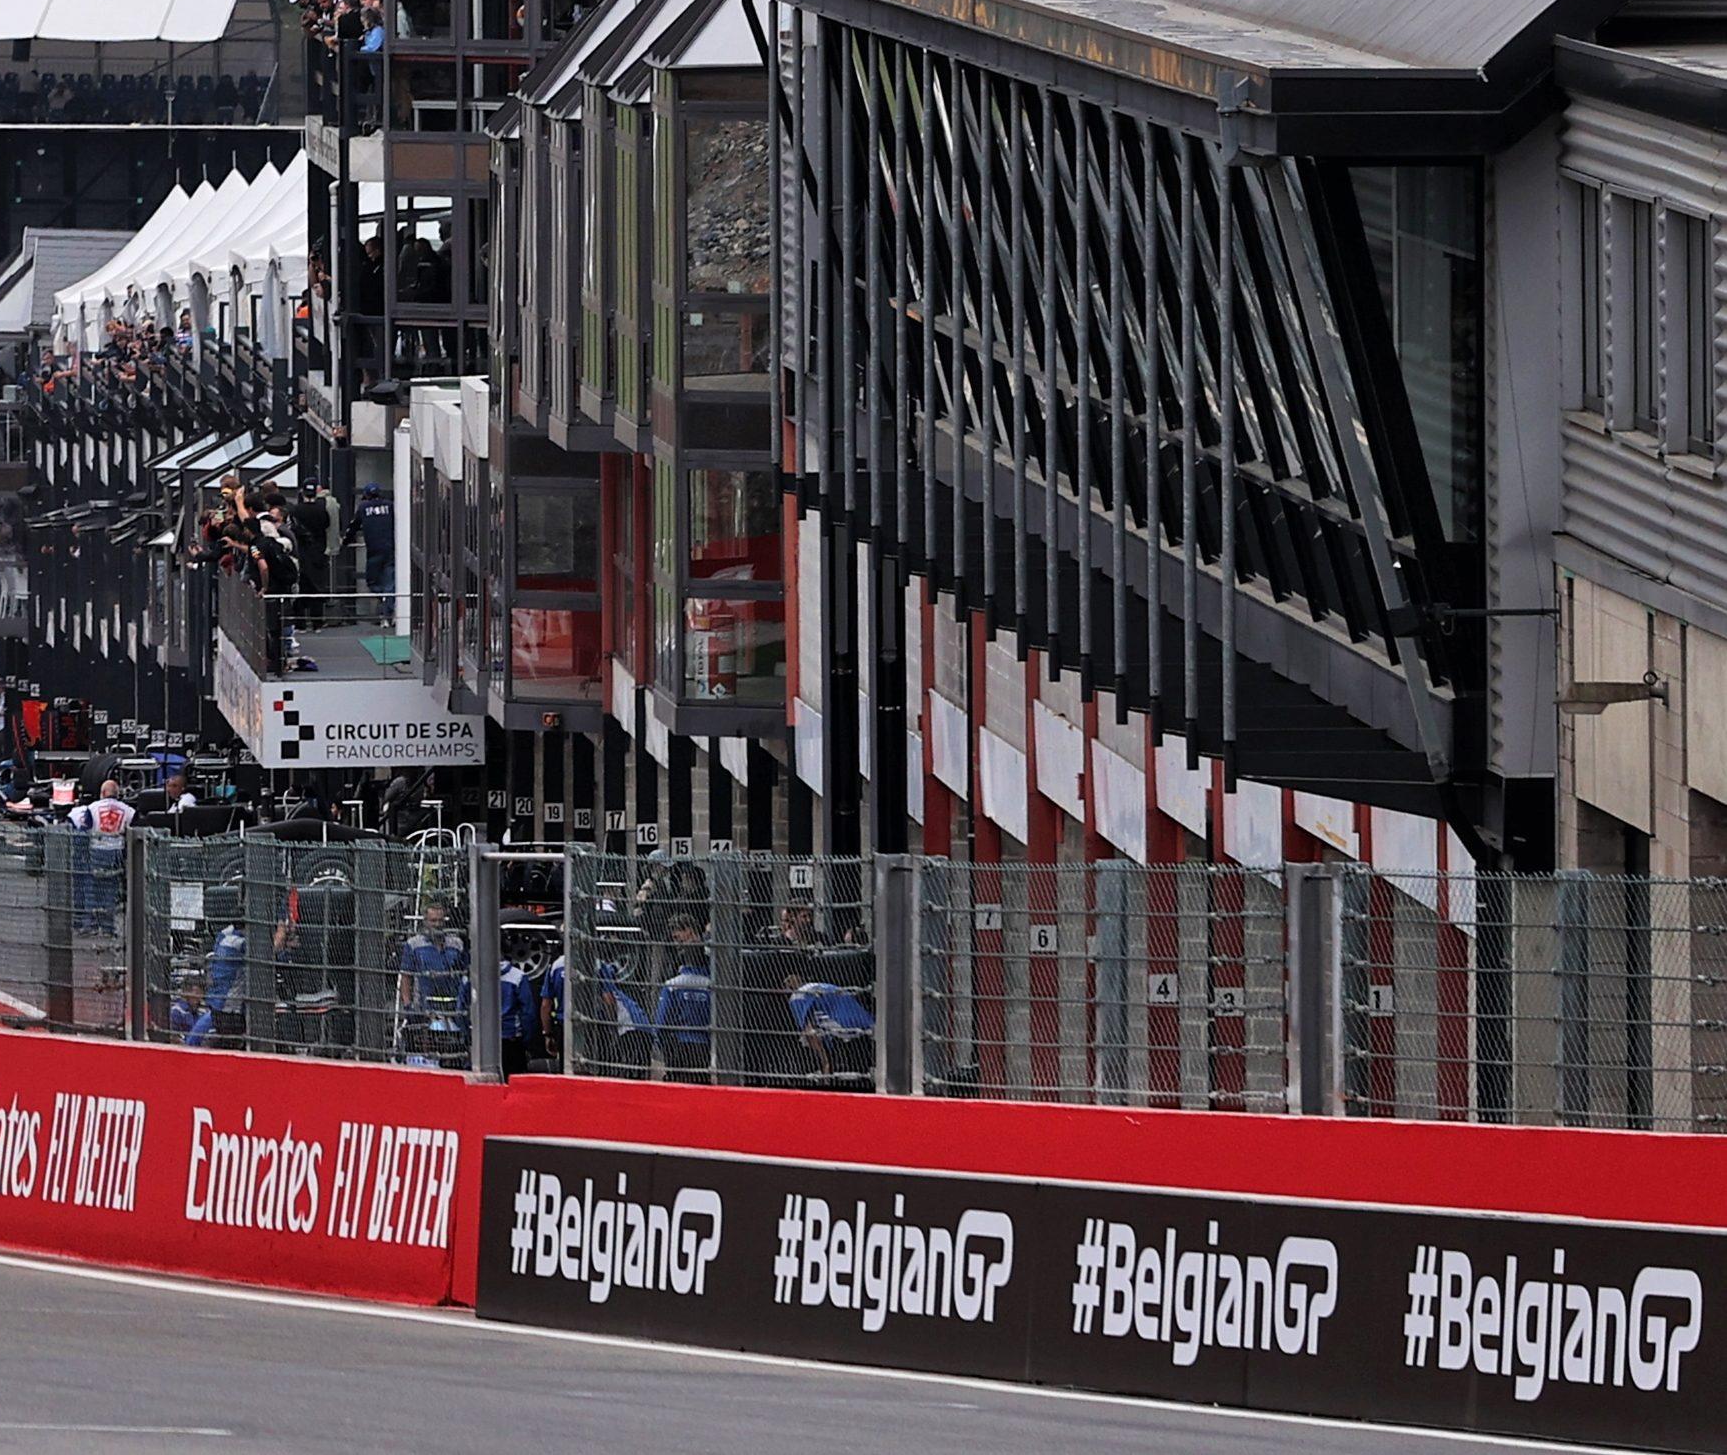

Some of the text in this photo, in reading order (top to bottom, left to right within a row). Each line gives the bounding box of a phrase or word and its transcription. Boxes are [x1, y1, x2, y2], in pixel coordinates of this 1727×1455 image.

[326, 722, 473, 740] CIRCUIT DE SPA
[326, 743, 475, 759] FRANCORCHAMPS
[490, 792, 504, 808] 21
[517, 799, 532, 814] 20
[548, 806, 560, 821] 19
[577, 811, 590, 826] 18
[609, 813, 622, 829] 17
[639, 827, 656, 842] 16
[675, 840, 688, 855] 15
[1038, 929, 1048, 948] 6
[1156, 978, 1170, 1000] 4
[1373, 990, 1380, 1009] 1
[42, 1092, 82, 1203] FLY
[74, 1096, 145, 1212] BETTER
[185, 1106, 458, 1249] Emirates FLY BETTER
[510, 1169, 722, 1303] #BelgianGP
[773, 1193, 1014, 1332] #BelgianGP
[1072, 1218, 1339, 1365] #BelgianGP
[1403, 1244, 1703, 1401] #BelgianGP
